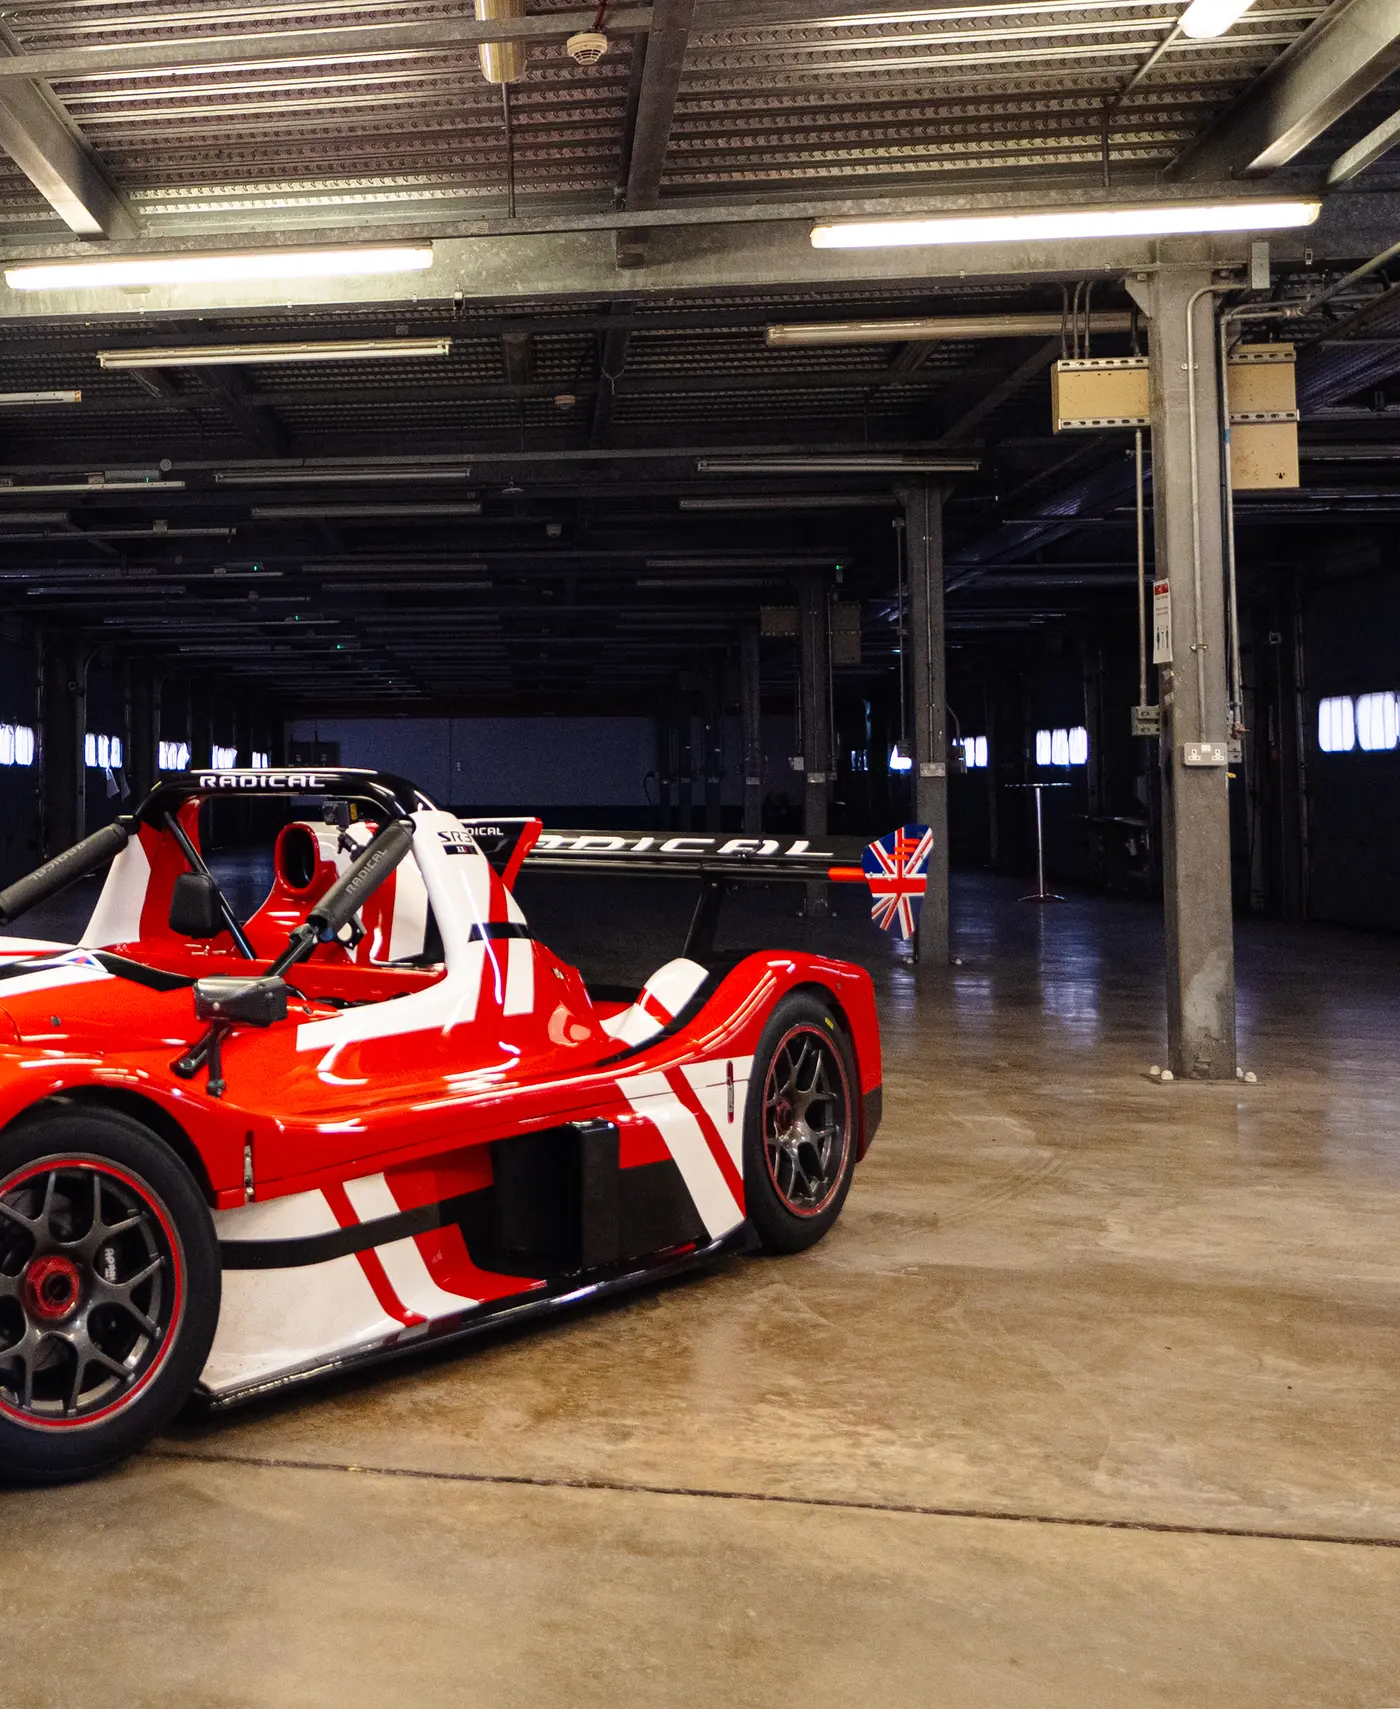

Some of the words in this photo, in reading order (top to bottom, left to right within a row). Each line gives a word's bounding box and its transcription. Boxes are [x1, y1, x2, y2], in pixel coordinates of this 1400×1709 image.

[200, 775, 325, 788] RADICAL
[437, 830, 473, 843] SR3
[345, 849, 387, 894] RADICAL
